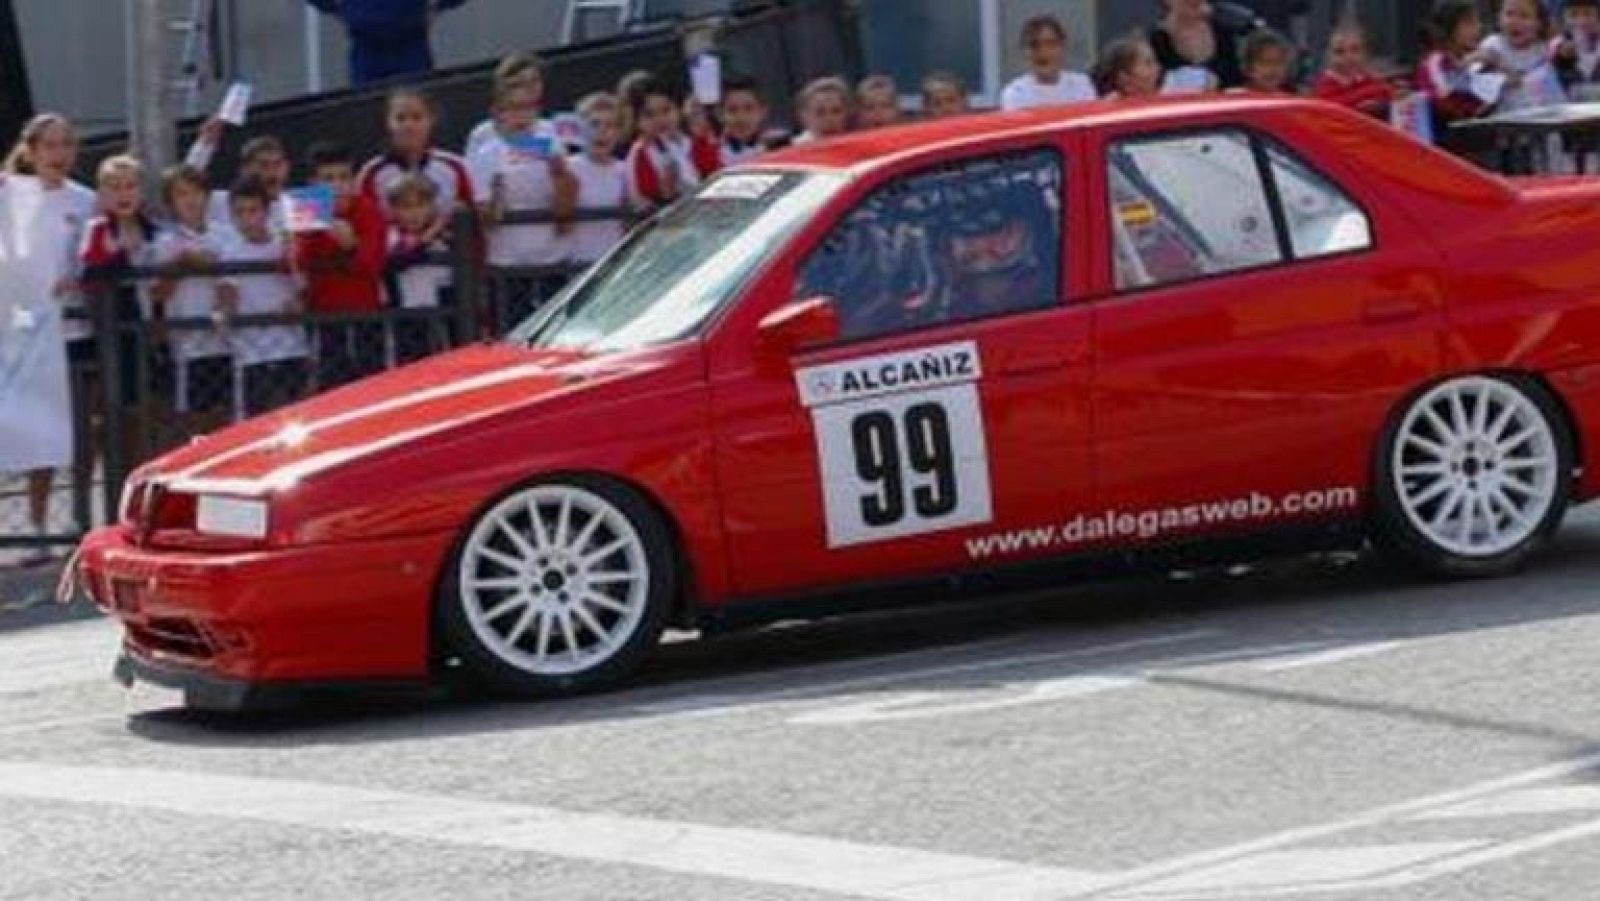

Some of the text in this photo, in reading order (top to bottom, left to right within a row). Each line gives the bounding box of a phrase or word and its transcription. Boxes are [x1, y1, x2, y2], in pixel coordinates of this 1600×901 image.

[841, 352, 973, 392] ALCAÑIZ
[851, 401, 959, 527] 99
[964, 486, 1357, 559] www.dalegasweb.com
